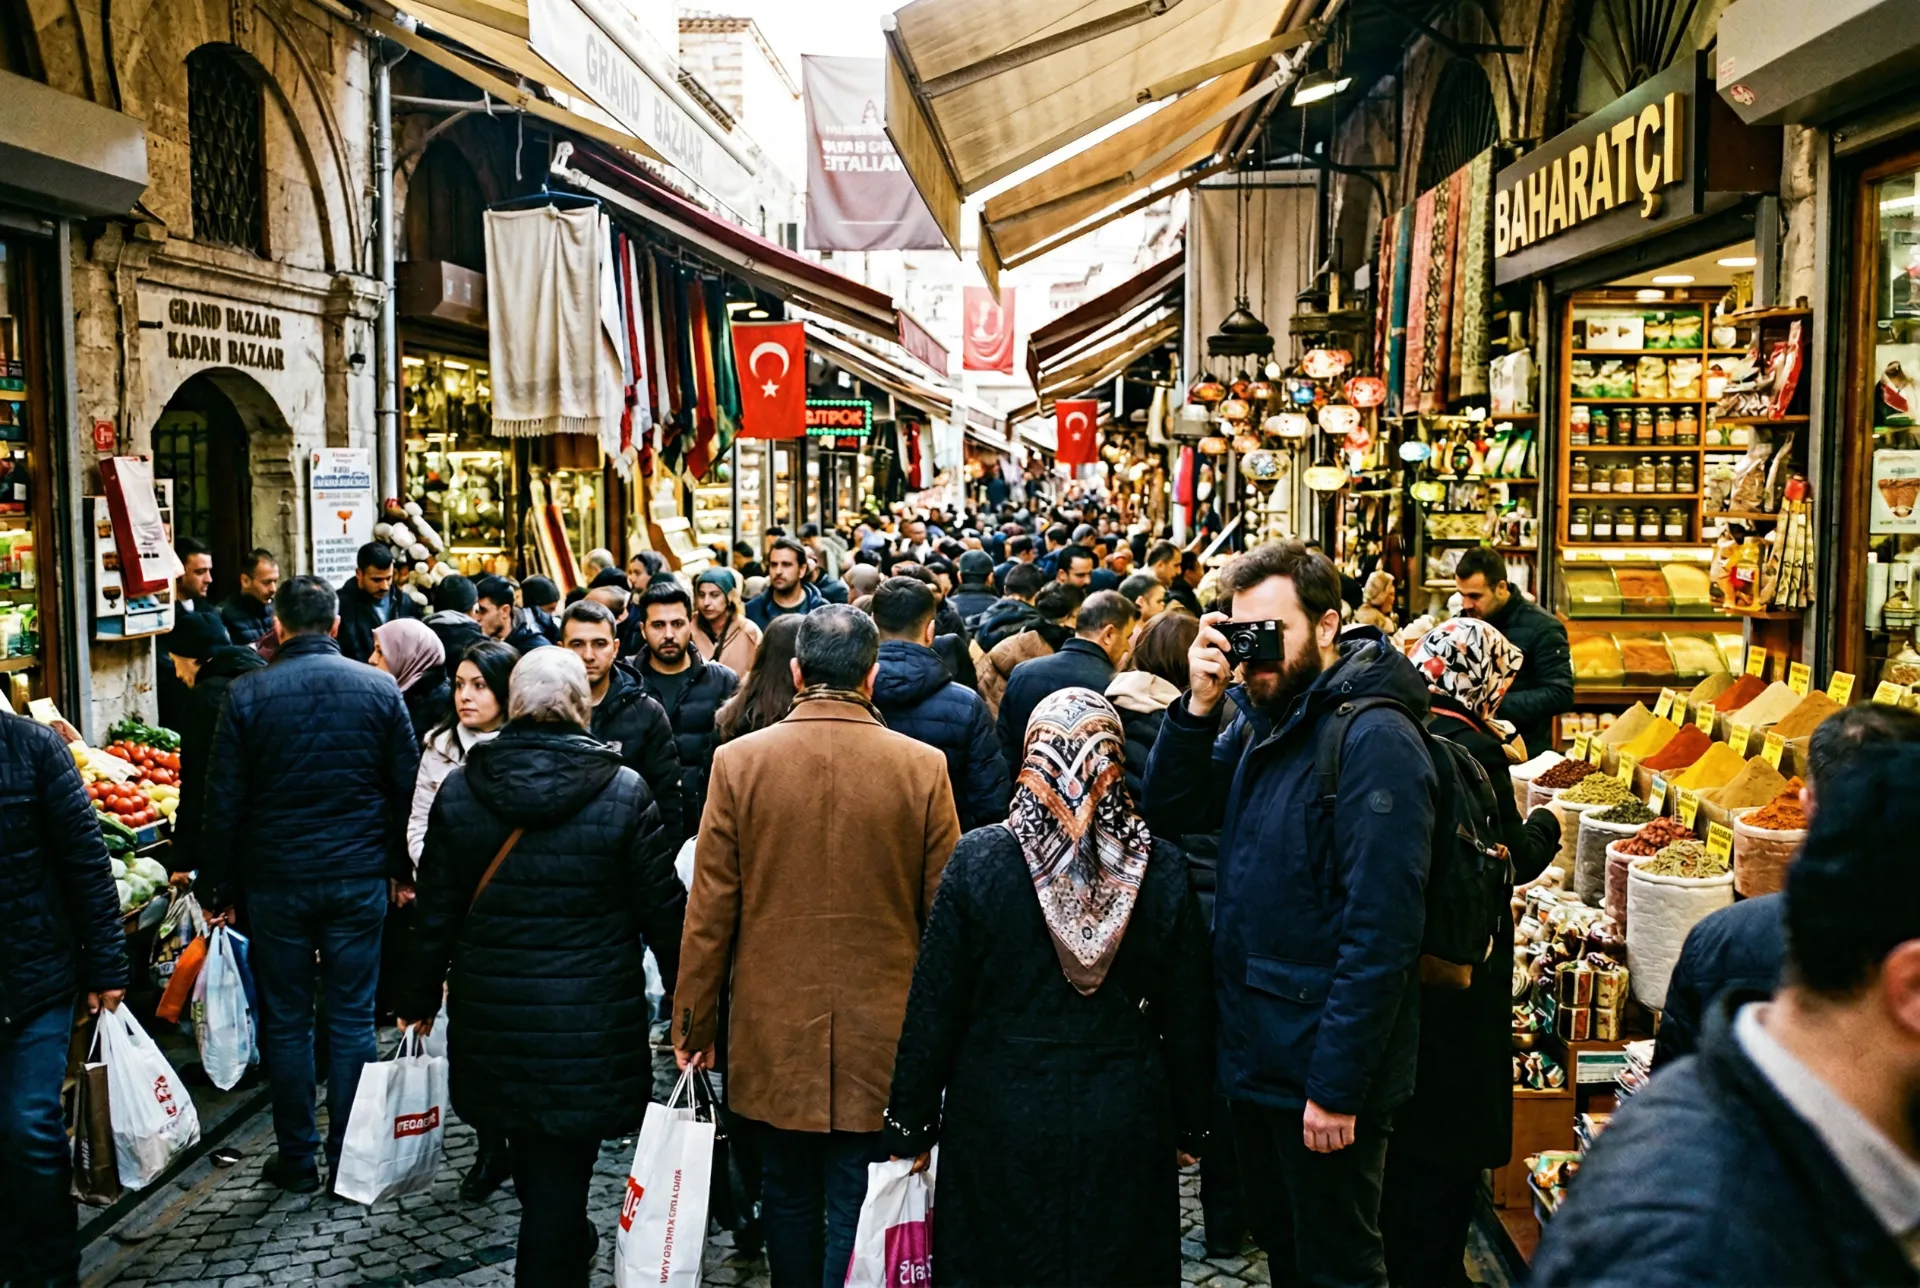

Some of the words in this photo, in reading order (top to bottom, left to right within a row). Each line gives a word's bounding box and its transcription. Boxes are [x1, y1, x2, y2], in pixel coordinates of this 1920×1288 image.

[585, 33, 640, 123] GRAND
[654, 96, 703, 177] BAZAAR
[1494, 92, 1684, 258] BAHARATÇI
[167, 331, 222, 363] KAPAN
[228, 339, 284, 371] BAZAAR
[169, 298, 221, 330] GRAND
[226, 307, 281, 339] BAZAAR
